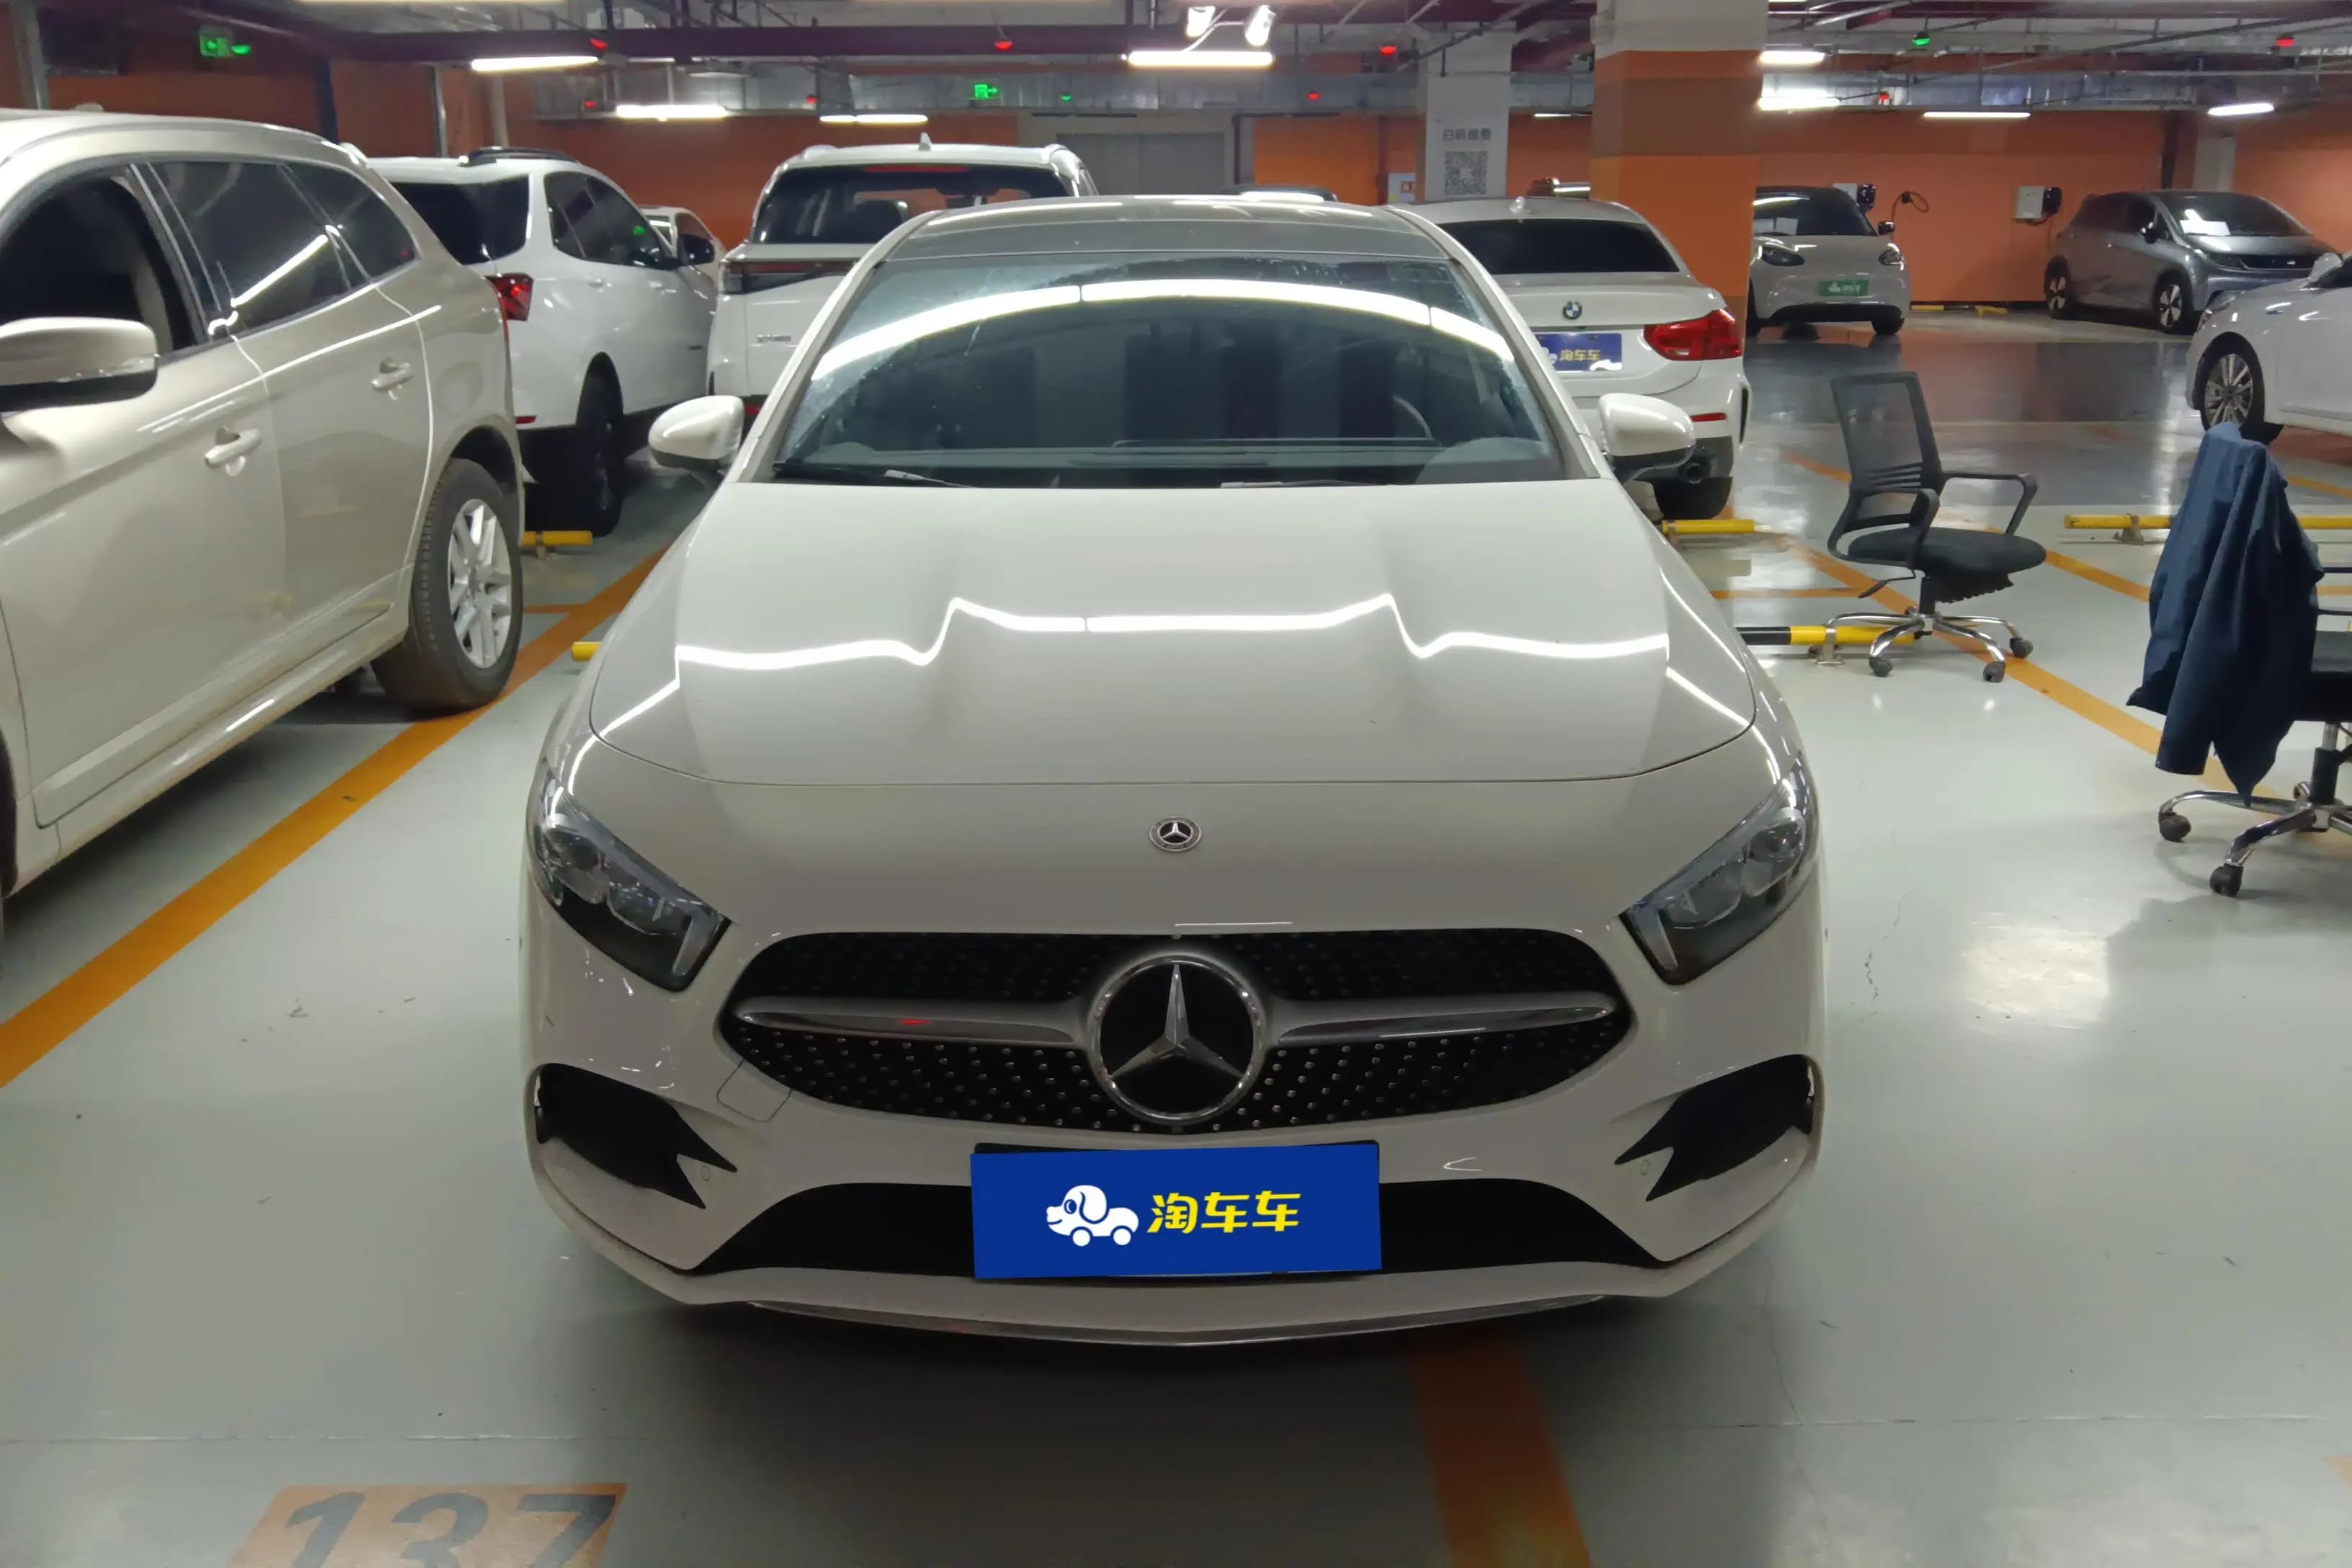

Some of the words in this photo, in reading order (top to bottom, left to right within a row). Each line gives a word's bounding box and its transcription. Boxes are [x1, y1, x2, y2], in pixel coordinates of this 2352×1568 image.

[1559, 349, 1601, 362] 淘车车
[284, 1491, 618, 1568] 137
